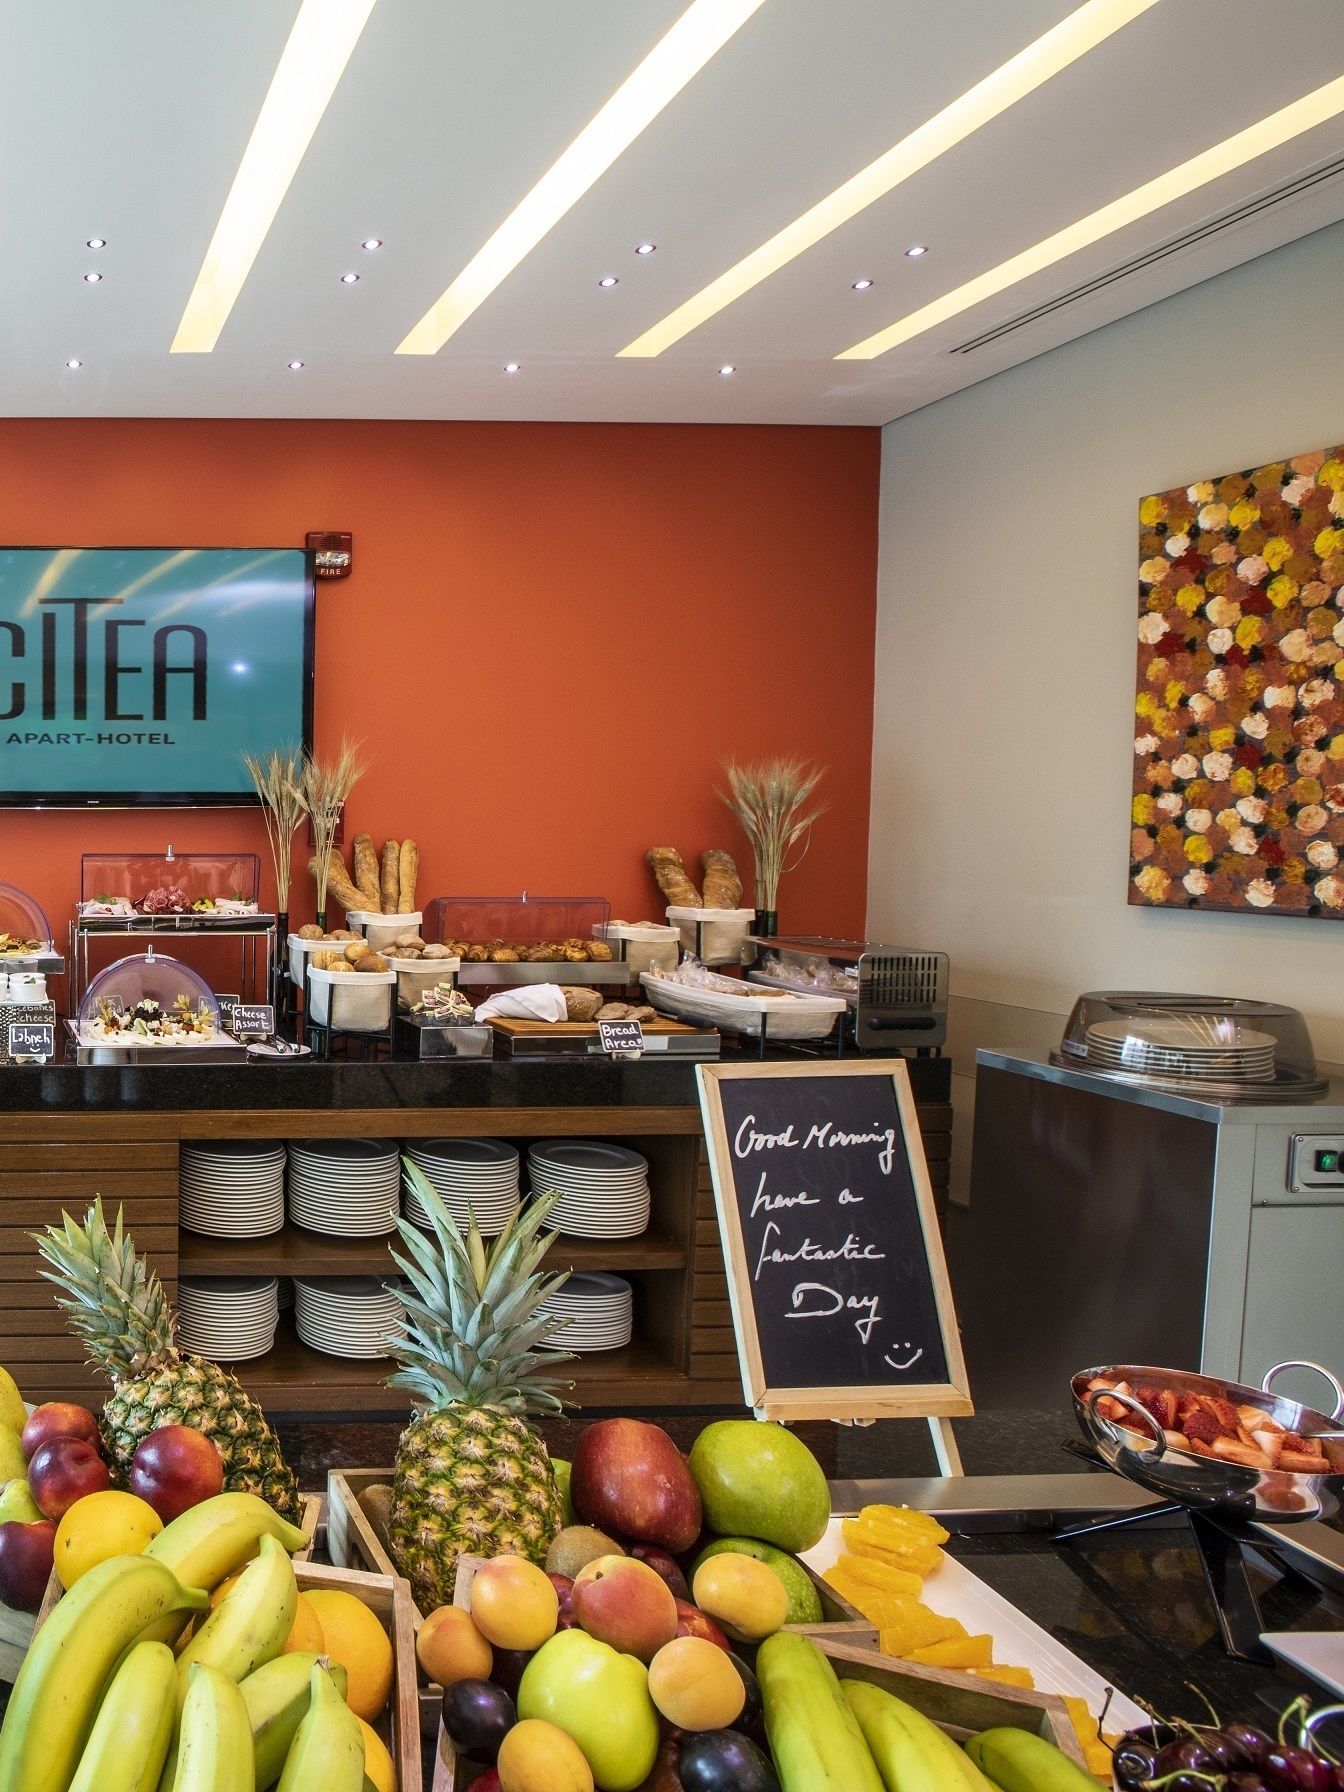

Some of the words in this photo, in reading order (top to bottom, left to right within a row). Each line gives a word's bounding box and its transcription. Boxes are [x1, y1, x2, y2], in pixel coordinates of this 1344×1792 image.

[320, 568, 342, 576] FIRE
[6, 732, 176, 746] APART-HOTEL
[235, 1006, 267, 1020] Cheese
[235, 1020, 270, 1031] Assort
[601, 1023, 639, 1037] Bread
[12, 1027, 51, 1045] Labneh
[734, 1114, 799, 1159] Good
[803, 1122, 896, 1175] Morning
[750, 1171, 821, 1218] have
[838, 1188, 865, 1205] a
[754, 1220, 887, 1282] fantastic
[784, 1282, 884, 1345] Day
